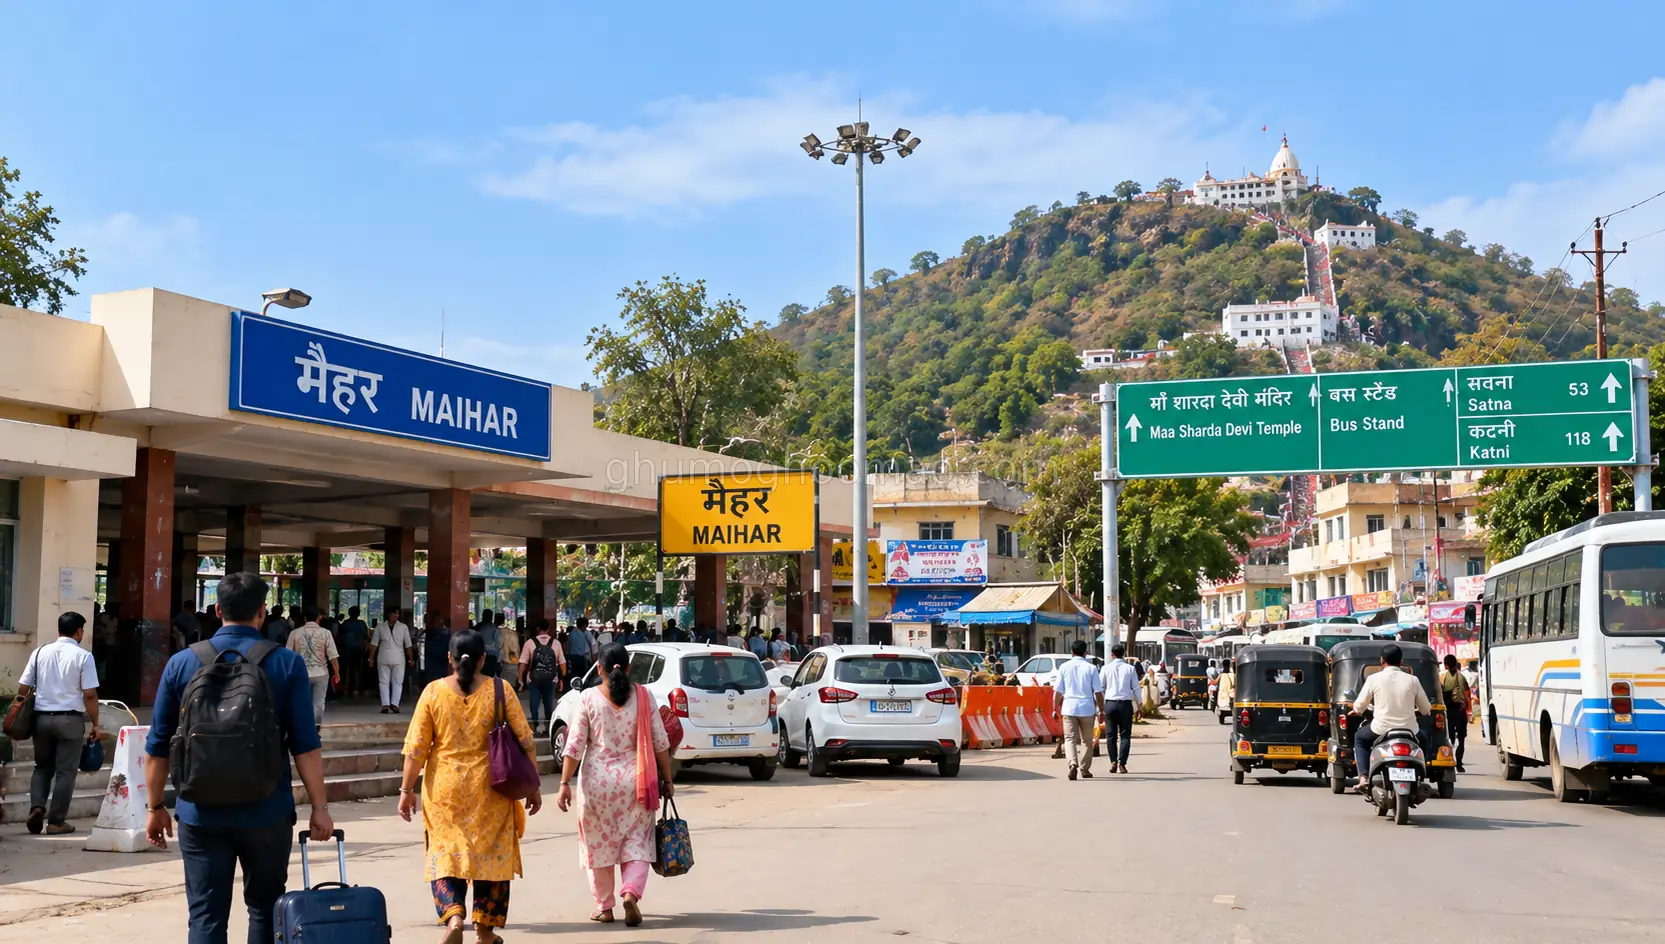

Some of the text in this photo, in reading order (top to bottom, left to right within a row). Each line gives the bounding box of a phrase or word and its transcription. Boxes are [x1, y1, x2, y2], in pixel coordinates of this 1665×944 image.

[295, 341, 383, 414] मैहर
[1172, 394, 1216, 411] शारदा
[1220, 387, 1249, 410] देवी
[1254, 386, 1293, 407] मंदिर
[1328, 387, 1357, 403] बस
[1568, 382, 1589, 397] 53
[411, 387, 518, 439] MAIHAR
[1468, 397, 1512, 412] Satna
[1149, 419, 1302, 439] Maa Sharda Devi Temple
[1330, 415, 1405, 432] Bus Stand
[1565, 431, 1591, 446] 118
[1469, 444, 1510, 460] Katni
[701, 478, 772, 518] मैहर
[692, 523, 782, 545] MAIHAR
